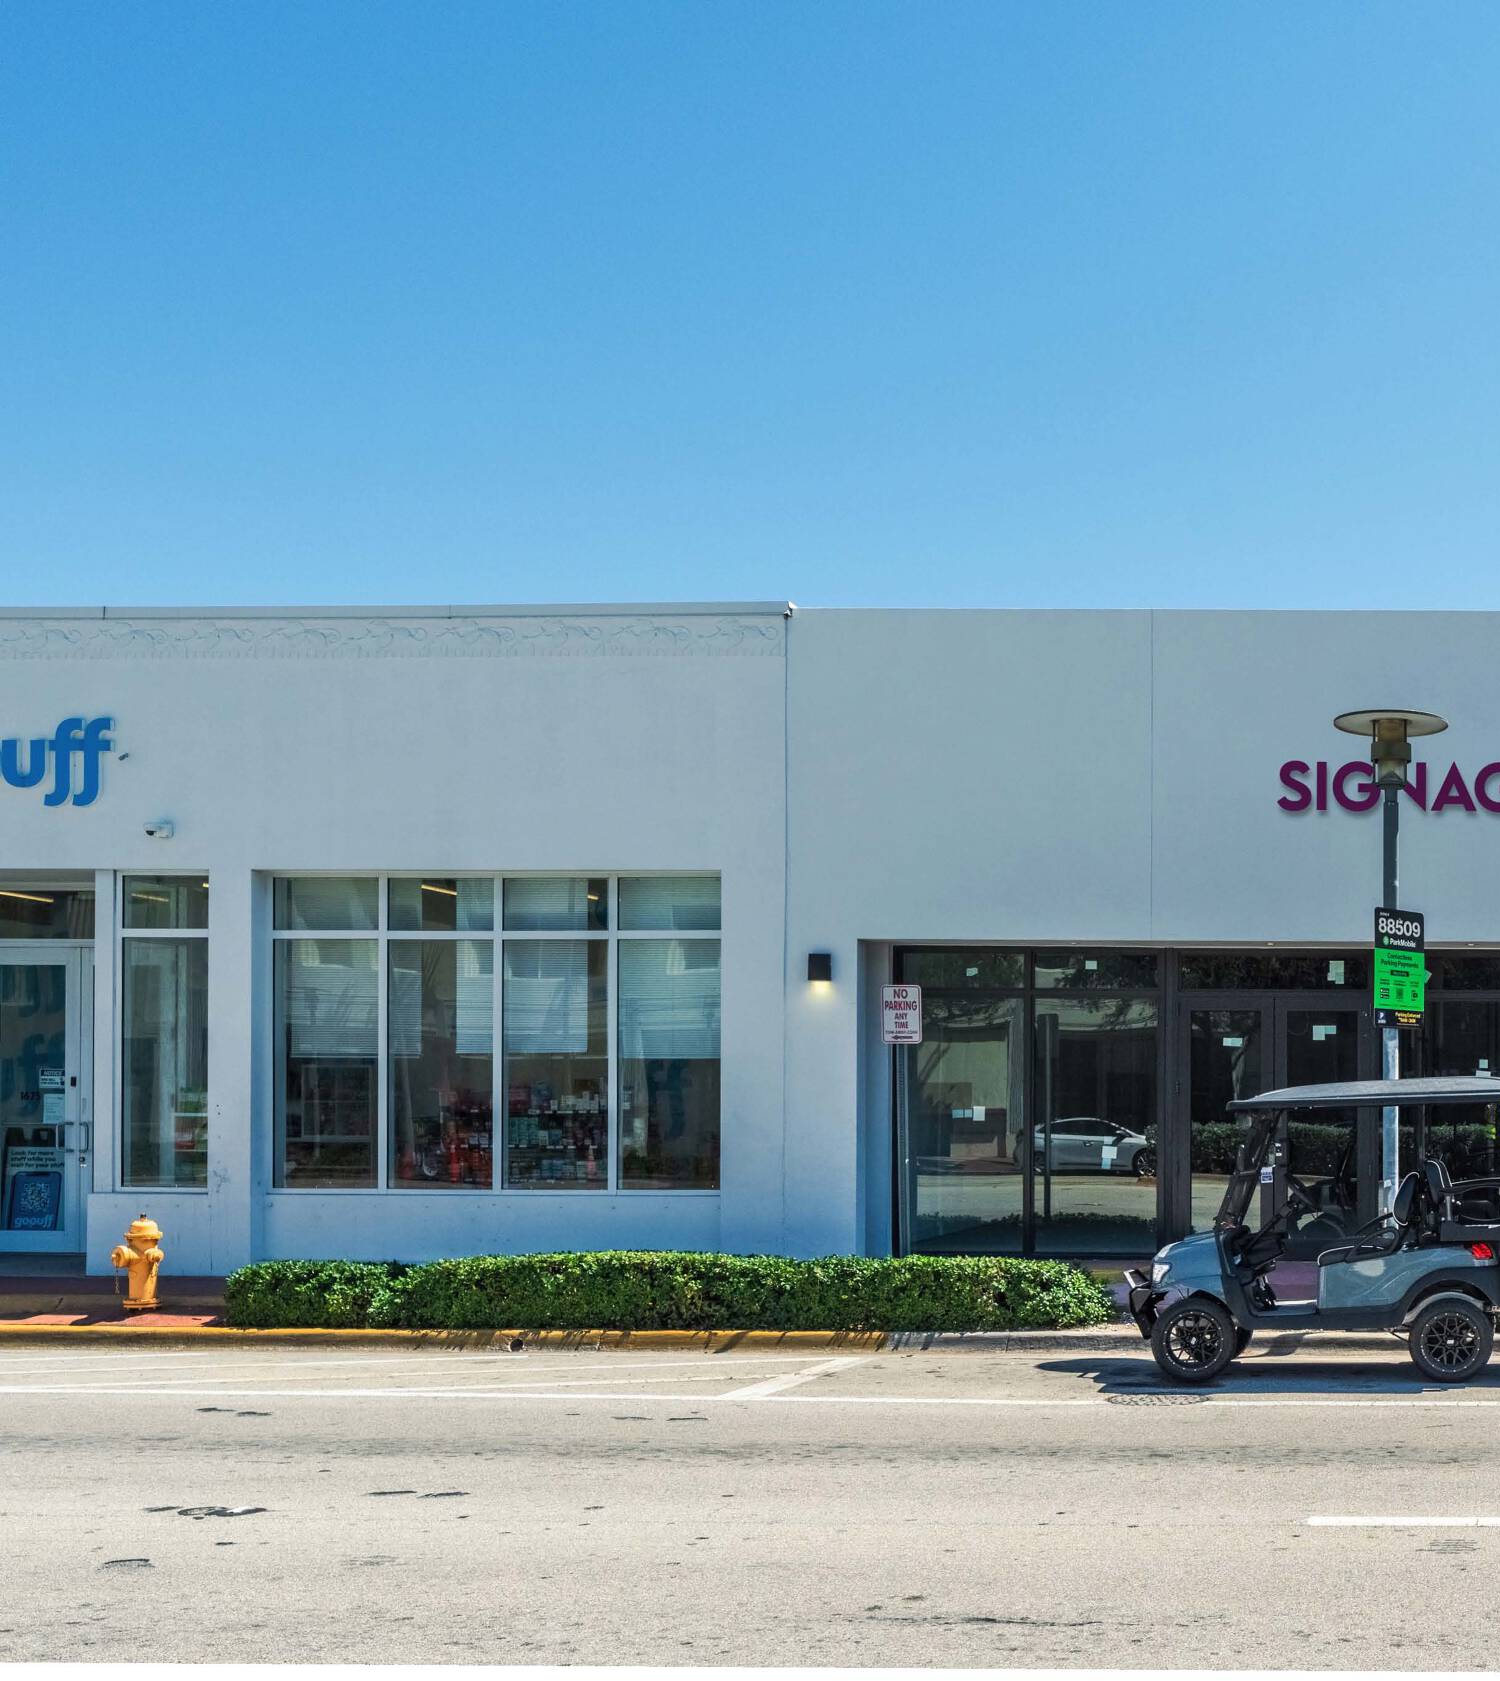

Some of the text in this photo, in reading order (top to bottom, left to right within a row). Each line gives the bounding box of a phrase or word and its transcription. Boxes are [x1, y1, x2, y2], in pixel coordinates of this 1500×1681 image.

[1378, 917, 1421, 938] 88509
[1389, 937, 1417, 949] ParkMobile
[893, 988, 908, 999] NO
[884, 1000, 918, 1011] PARKING
[894, 1012, 908, 1020] ANY
[894, 1021, 909, 1029] TIME
